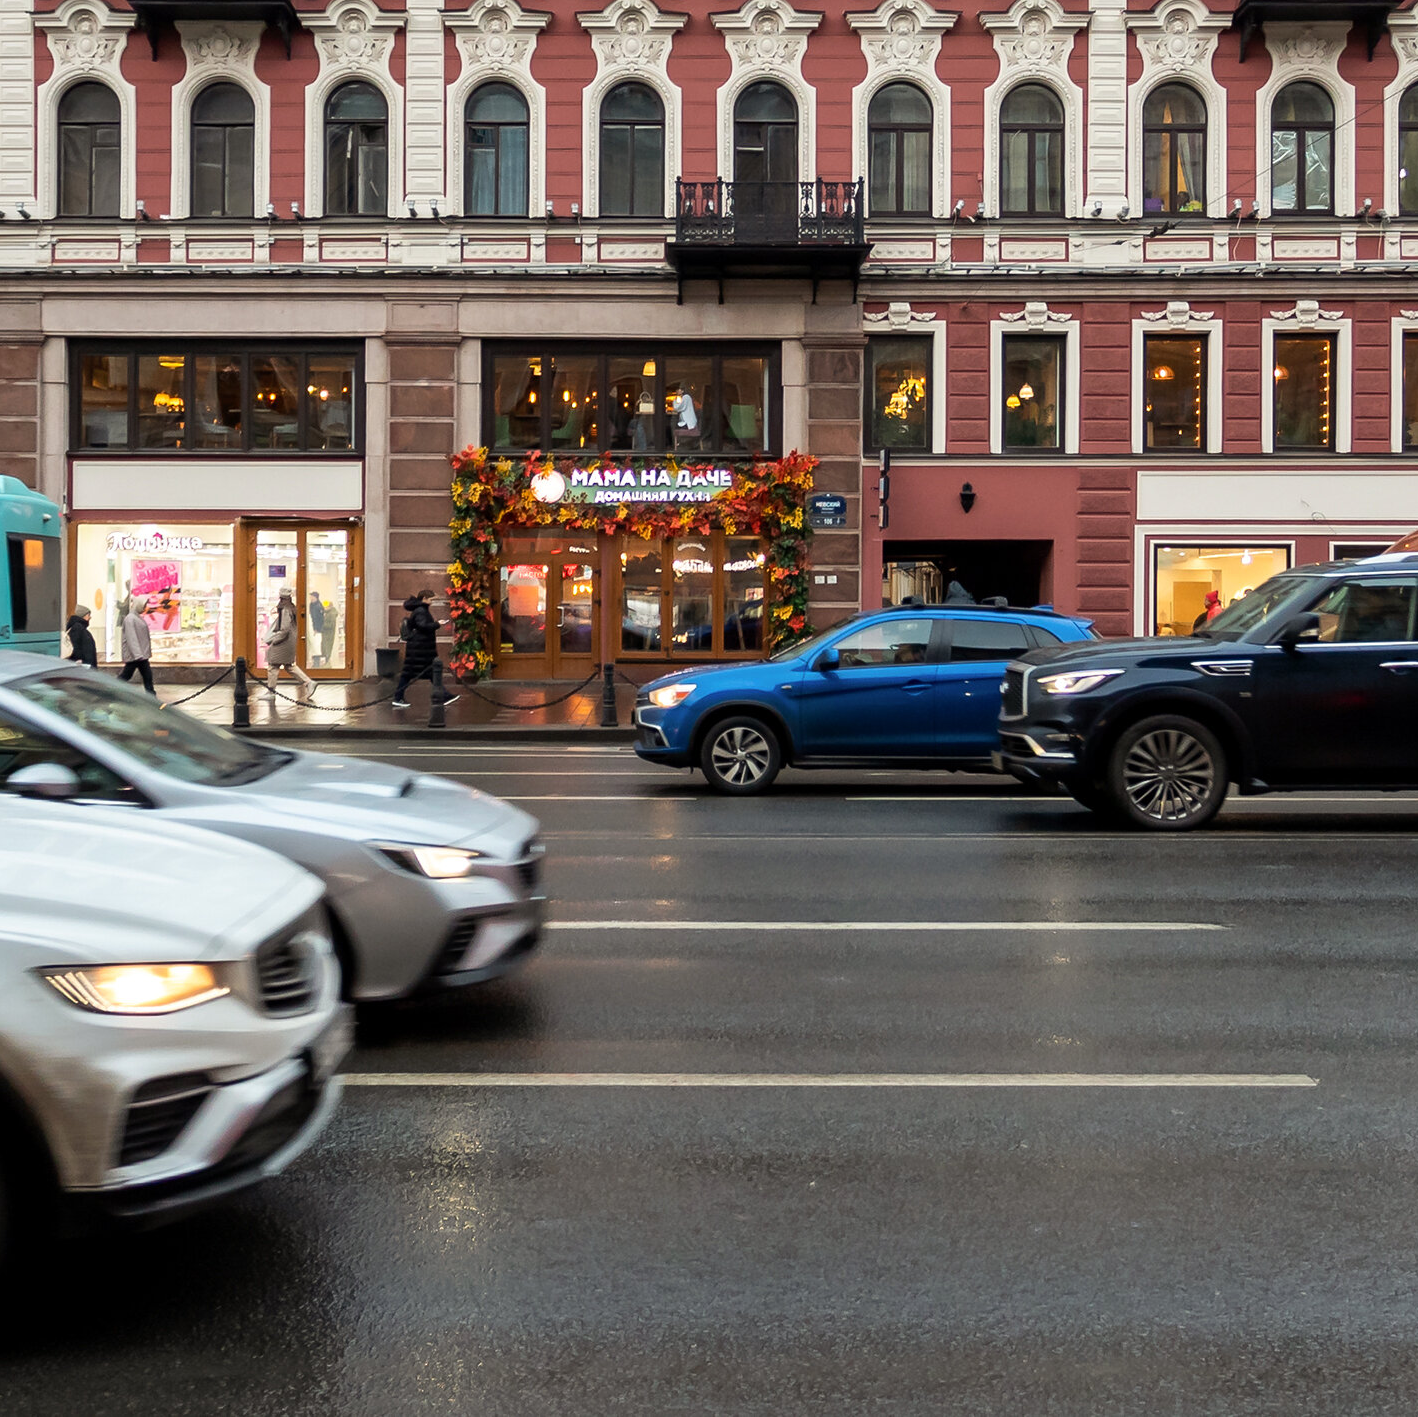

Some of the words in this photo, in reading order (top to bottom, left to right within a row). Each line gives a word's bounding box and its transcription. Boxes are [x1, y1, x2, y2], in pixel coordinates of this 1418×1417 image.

[571, 468, 636, 486] МАМА
[641, 468, 671, 486] НА
[676, 469, 732, 488] ДАЧЕ
